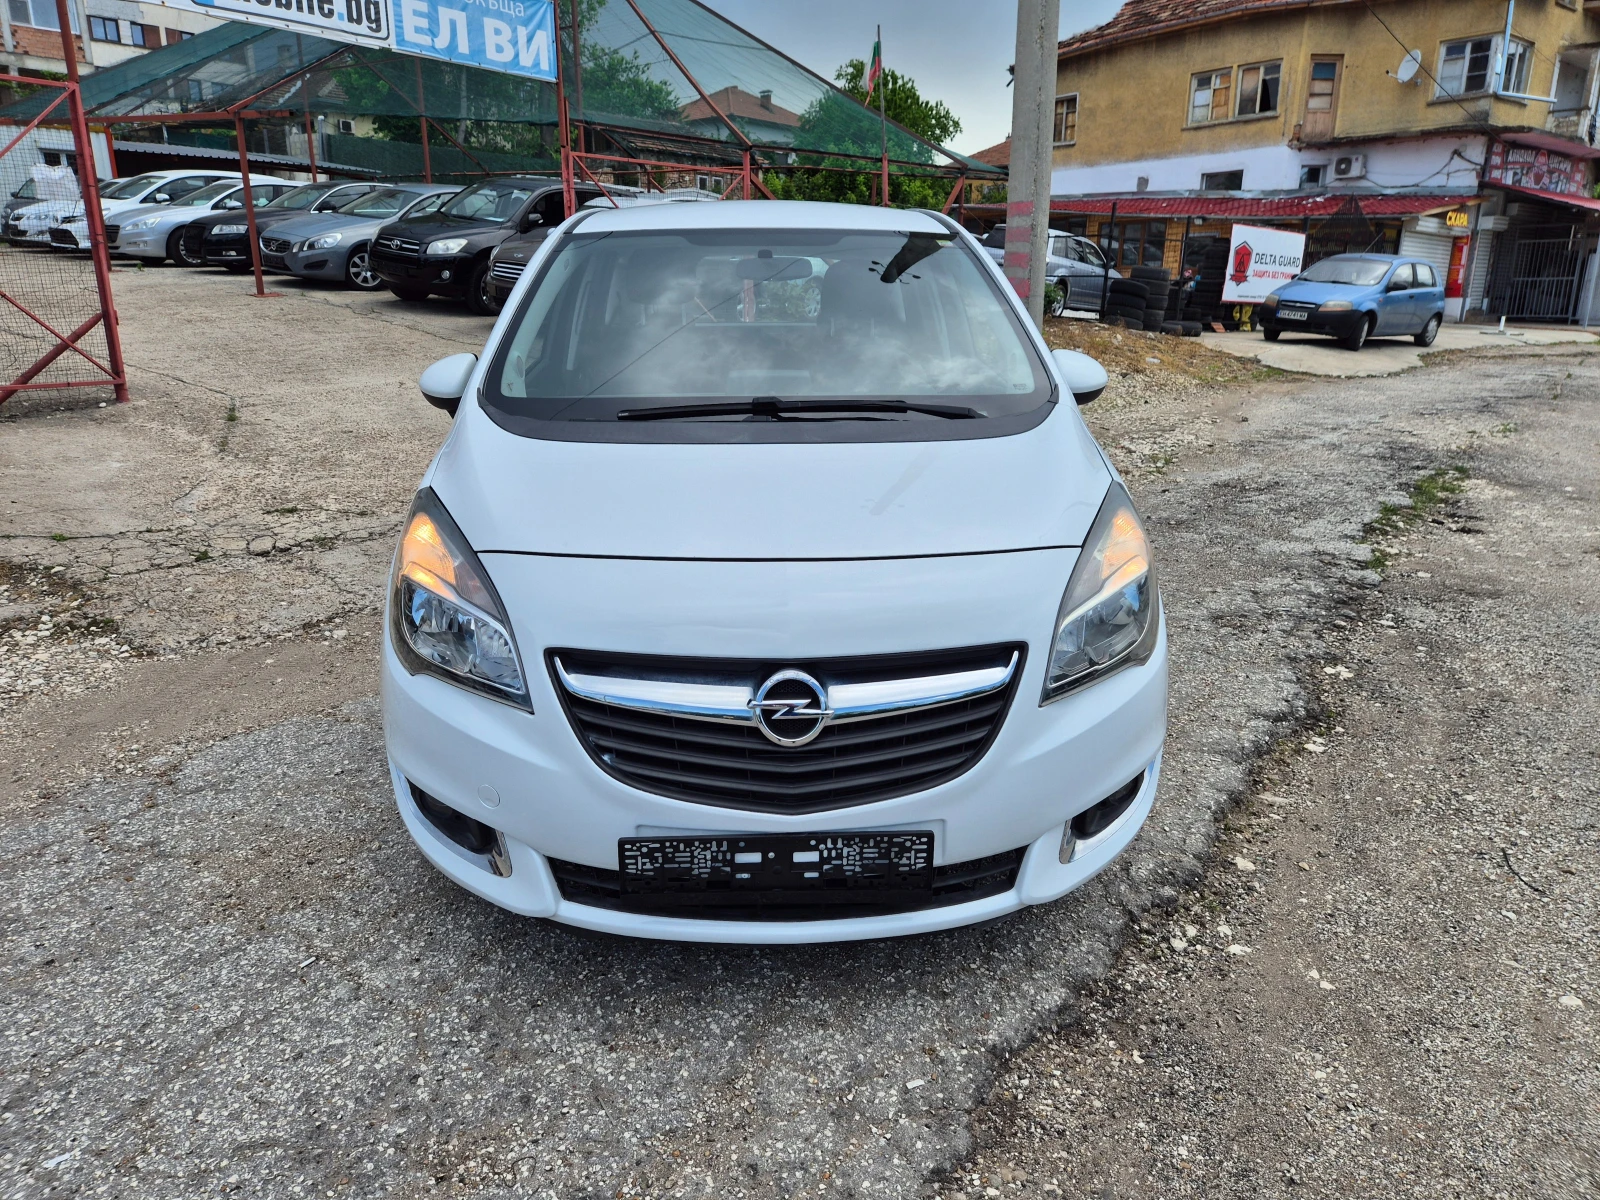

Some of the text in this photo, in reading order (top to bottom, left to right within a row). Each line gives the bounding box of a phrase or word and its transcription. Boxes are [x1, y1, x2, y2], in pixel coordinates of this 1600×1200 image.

[467, 0, 525, 18] ъща
[401, 0, 550, 71] ЕЛ ВИ
[1446, 211, 1468, 227] СКАРА
[1254, 252, 1301, 268] DELTA GUARD
[1252, 269, 1271, 279] ЗАЩИТА
[1271, 270, 1280, 280] БЕЗ
